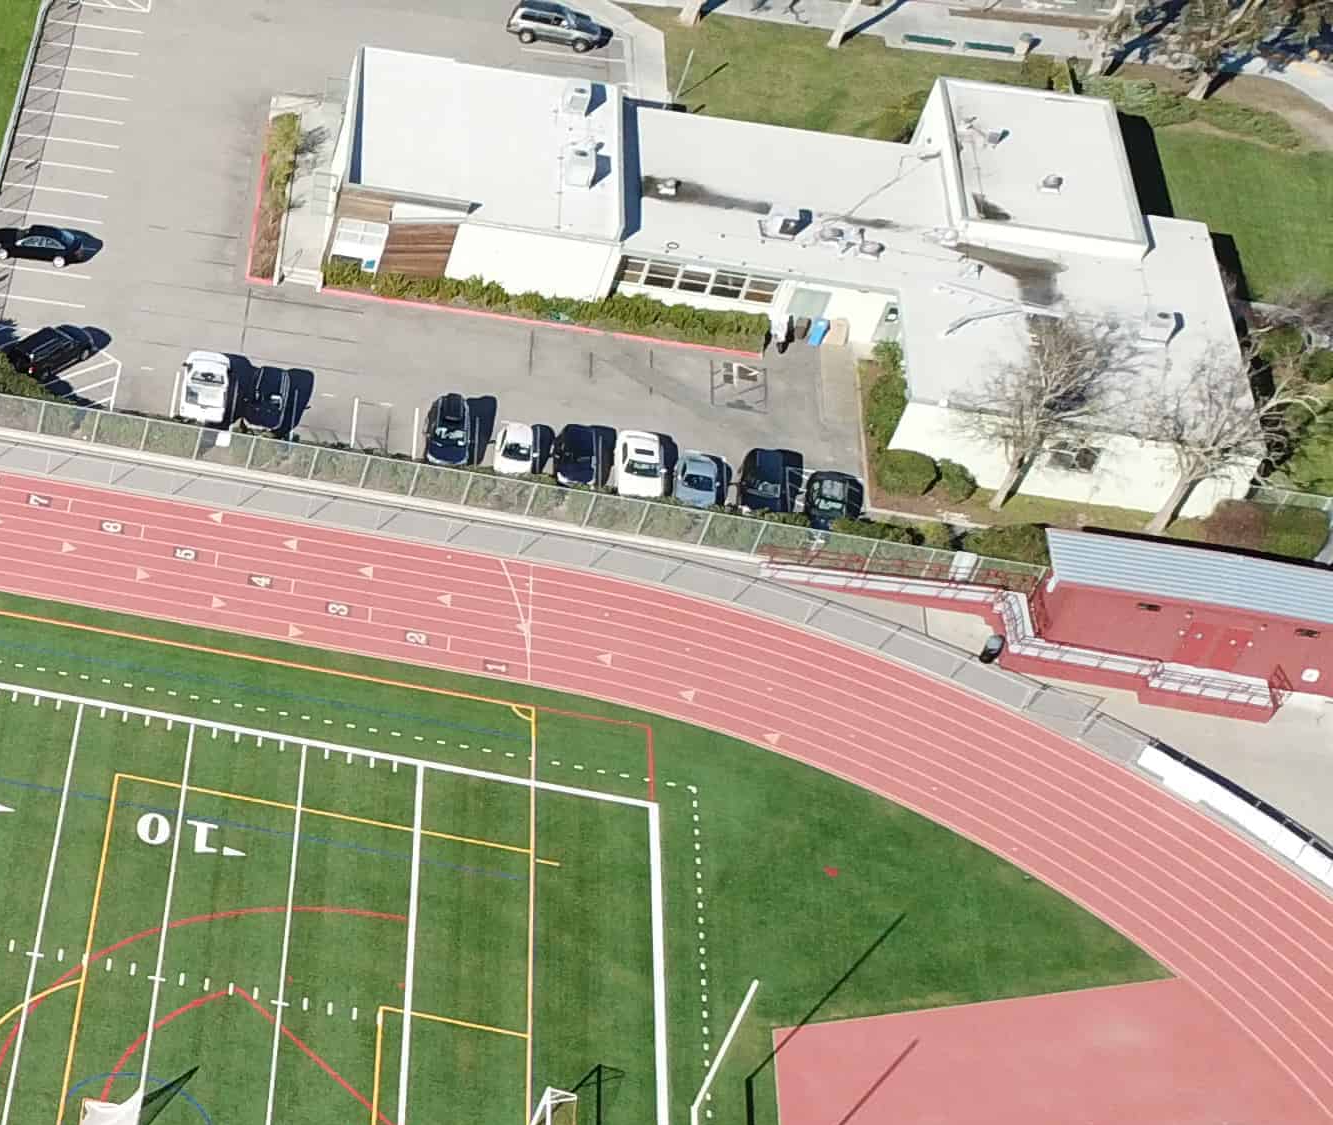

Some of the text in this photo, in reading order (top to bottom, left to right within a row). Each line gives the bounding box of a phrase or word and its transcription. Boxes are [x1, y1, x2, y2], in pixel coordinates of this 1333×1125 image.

[29, 494, 50, 507] 7
[102, 521, 122, 533] 6
[175, 548, 196, 560] 5
[250, 575, 271, 588] 4
[328, 603, 349, 615] 3
[406, 632, 427, 644] 2
[486, 662, 507, 673] 1
[135, 812, 219, 853] 10
